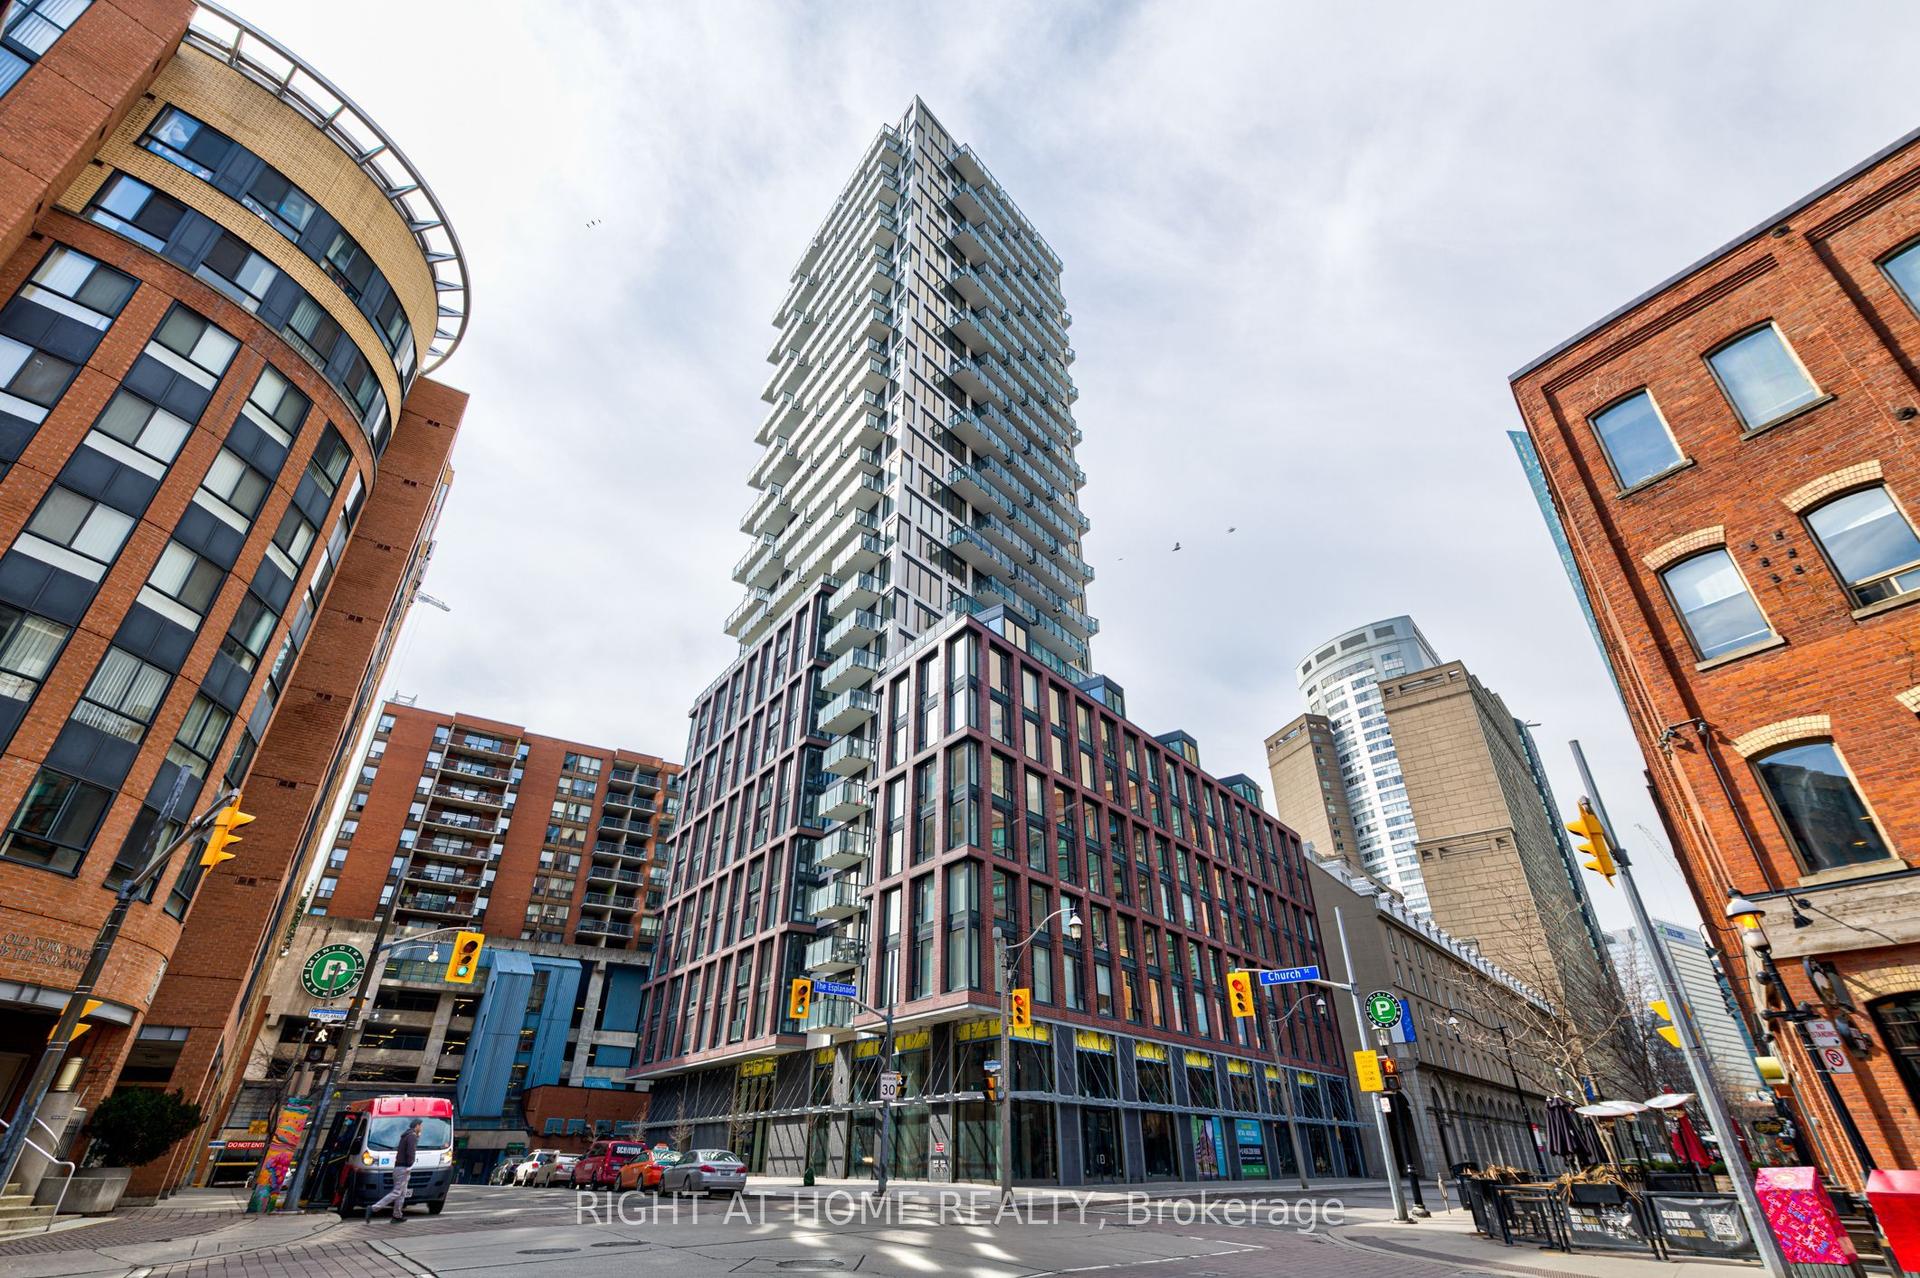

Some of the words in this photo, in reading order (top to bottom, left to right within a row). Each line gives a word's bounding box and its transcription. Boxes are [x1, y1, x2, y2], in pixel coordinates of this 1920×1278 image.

[4, 932, 30, 947] OLD
[35, 938, 62, 952] YORK
[65, 944, 92, 960] TOWE
[38, 954, 87, 972] ESPLANAD
[320, 960, 348, 980] P
[1268, 970, 1302, 981] Church
[304, 973, 359, 996] PARKING
[816, 981, 826, 990] The
[828, 984, 856, 995] Esplanade
[1376, 1000, 1390, 1016] P
[882, 1084, 895, 1096] 30
